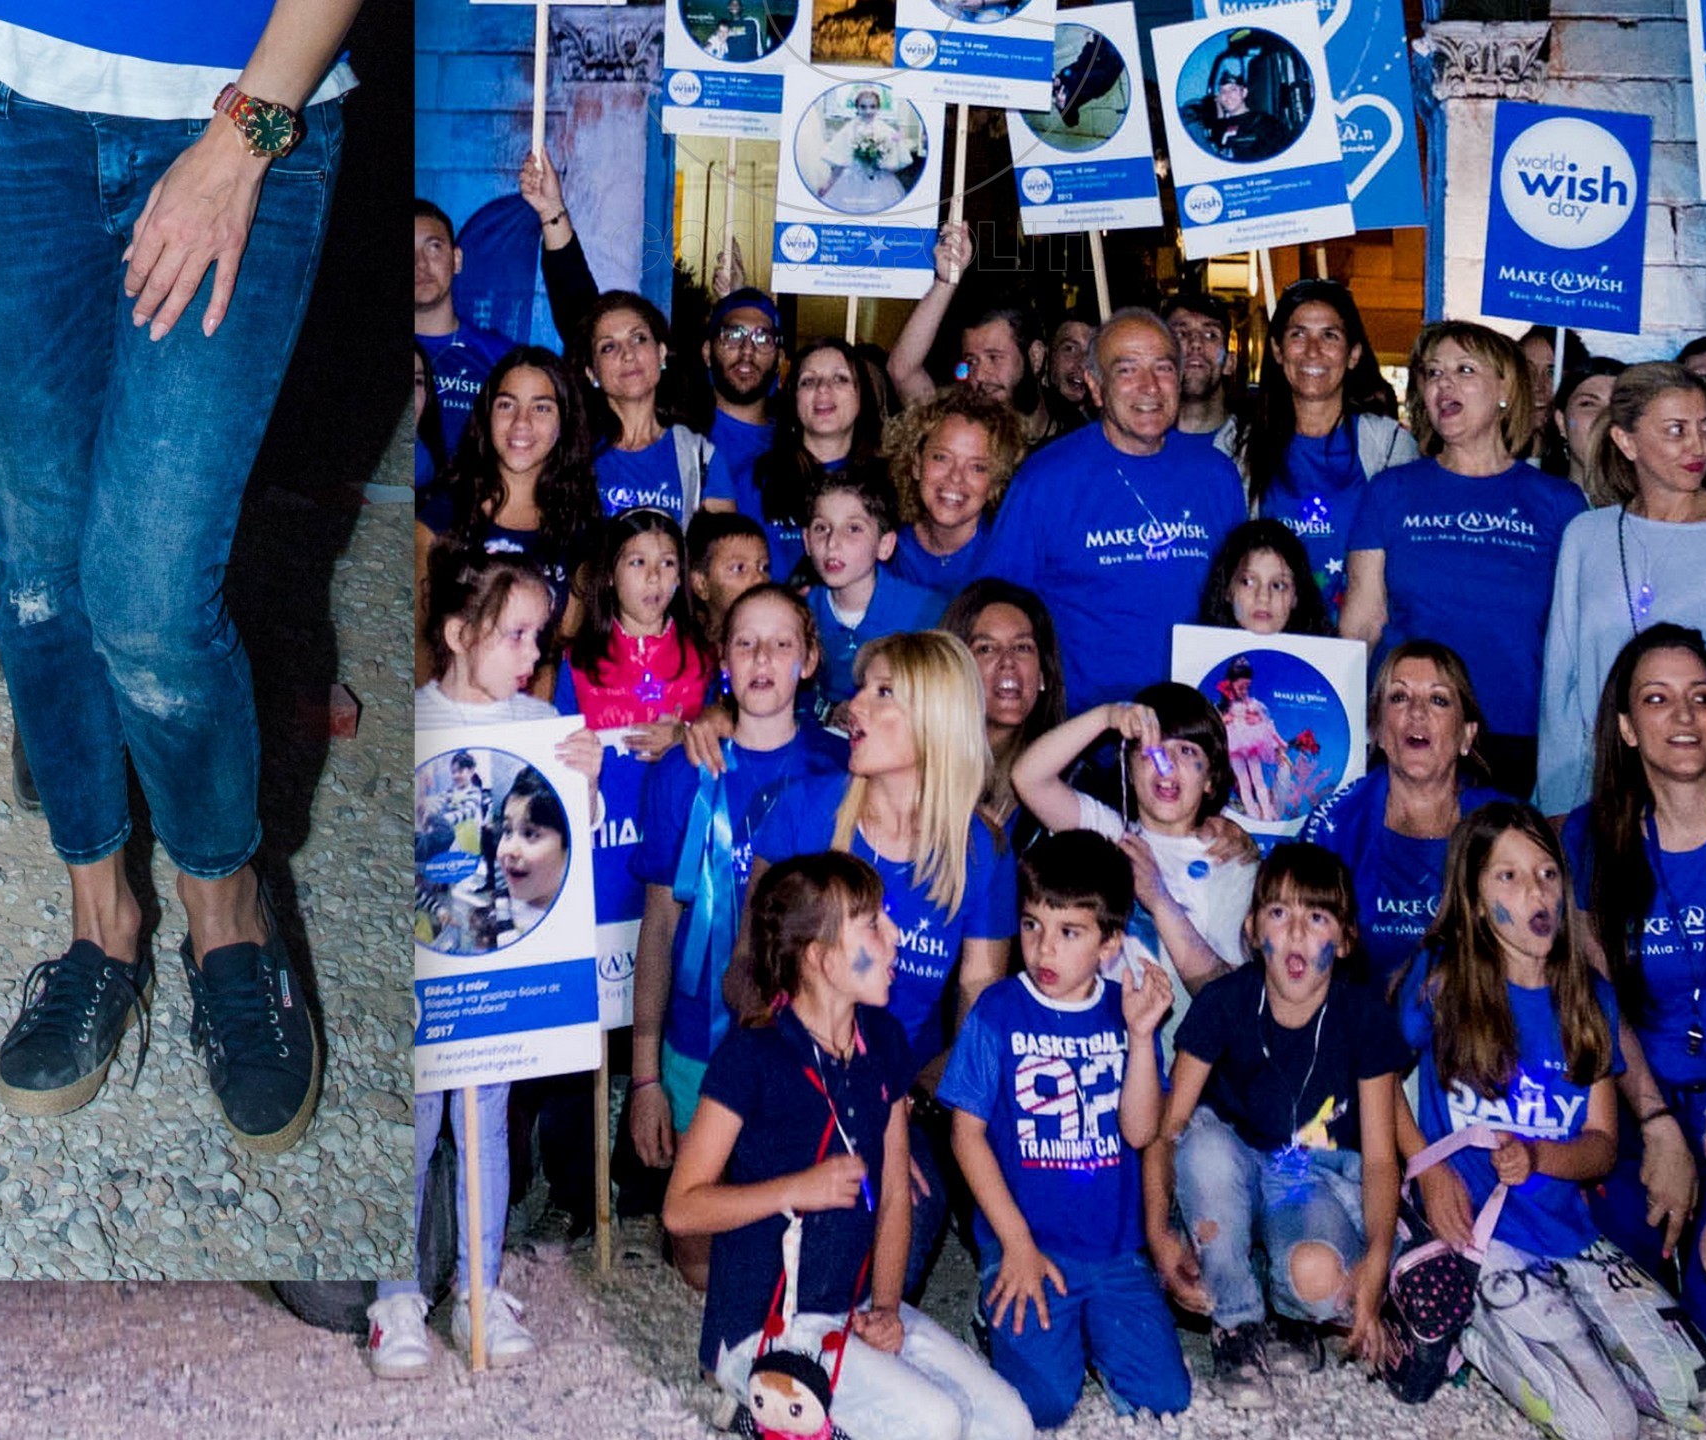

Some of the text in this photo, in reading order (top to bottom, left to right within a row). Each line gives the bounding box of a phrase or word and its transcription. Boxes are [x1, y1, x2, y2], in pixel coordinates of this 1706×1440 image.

[1515, 153, 1566, 172] world
[1518, 163, 1628, 206] wish
[1548, 195, 1589, 224] day
[425, 1024, 456, 1040] 2017
[1015, 1054, 1125, 1141] 92
